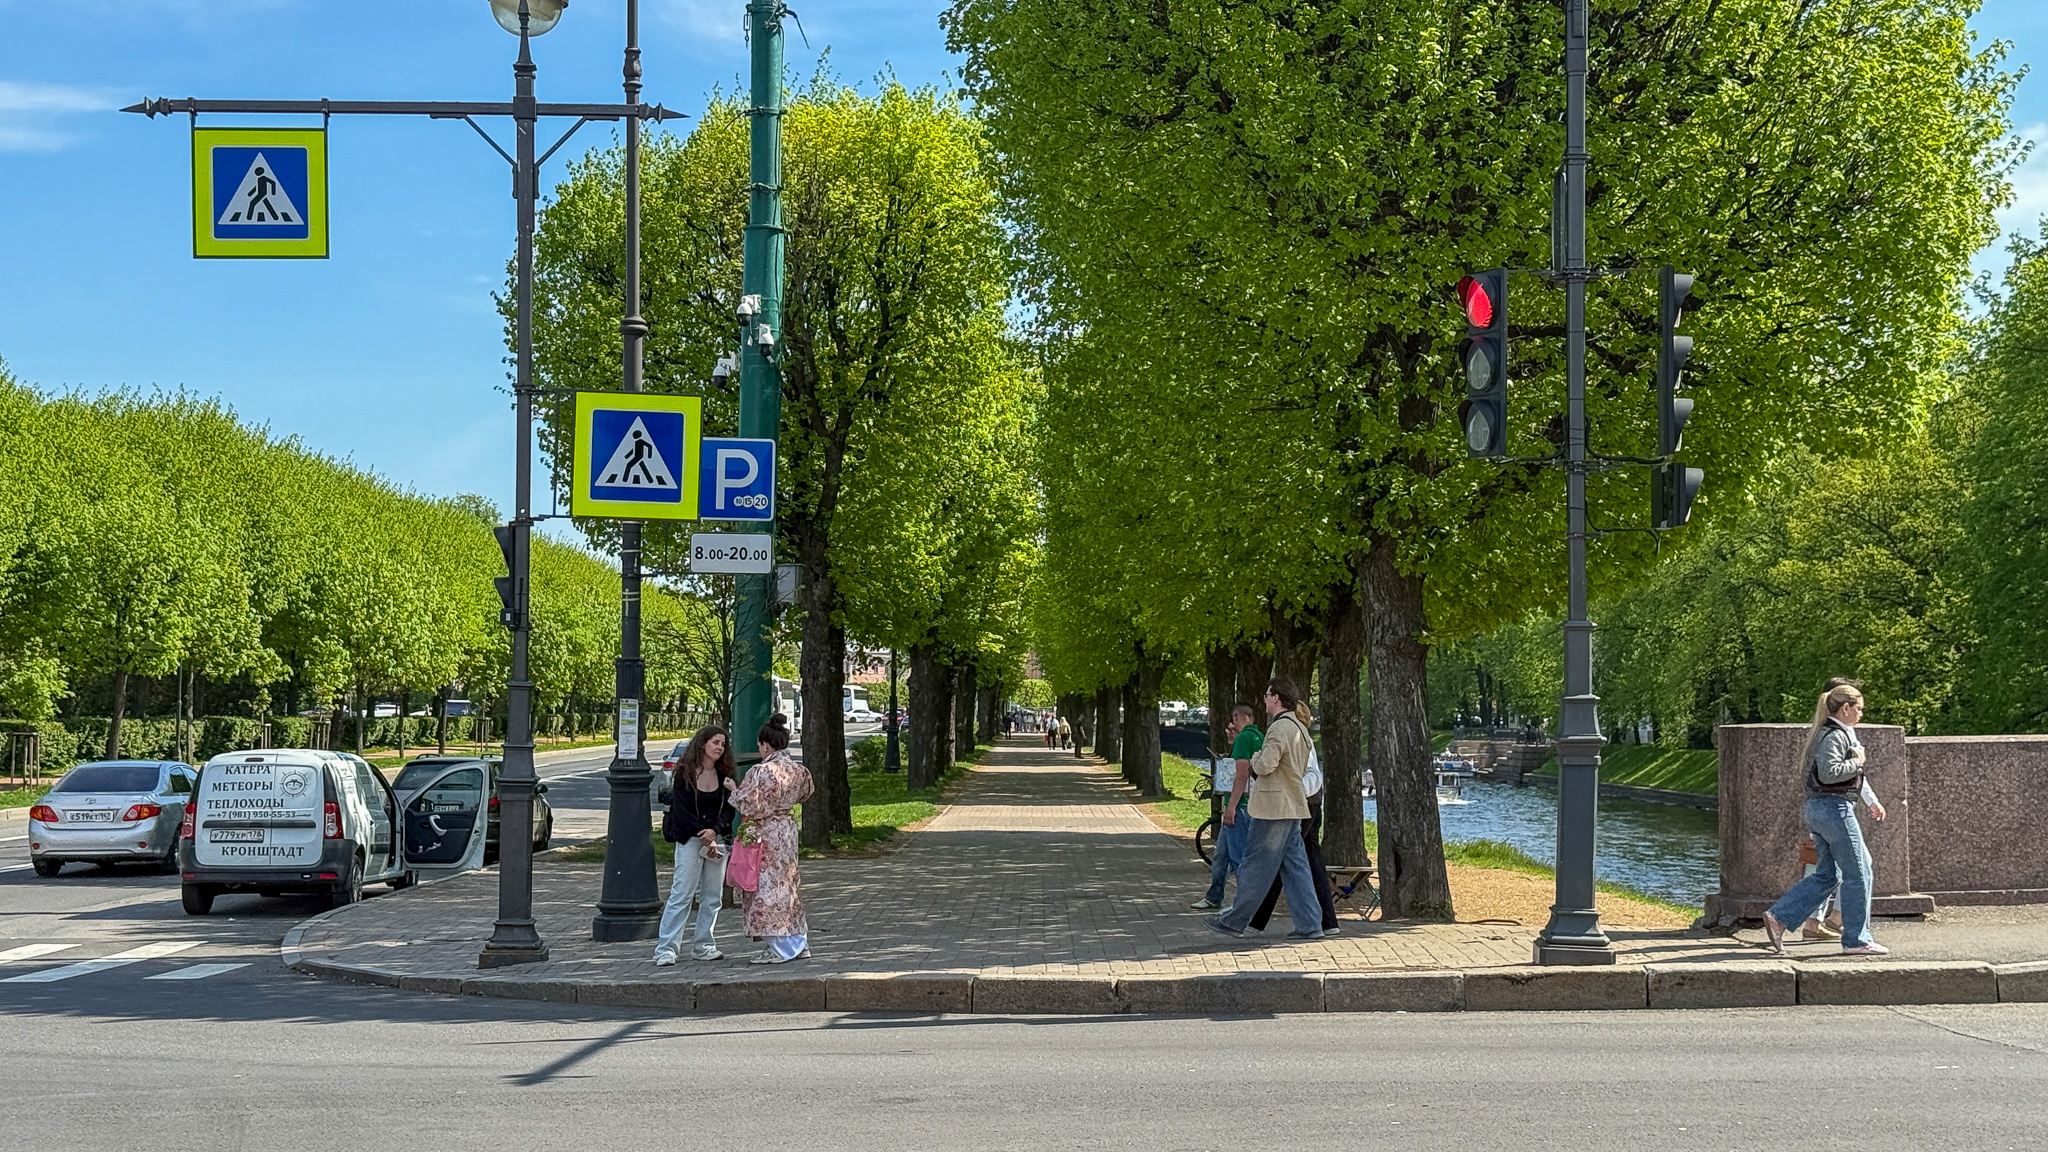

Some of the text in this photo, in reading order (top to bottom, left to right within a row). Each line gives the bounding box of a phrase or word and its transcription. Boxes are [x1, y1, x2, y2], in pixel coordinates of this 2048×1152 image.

[716, 449, 758, 509] P
[754, 497, 767, 507] 20
[694, 546, 768, 561] 8.00-20.00
[225, 765, 271, 775] КАТЕРА
[212, 781, 273, 792] МЕТЕОРЫ
[207, 798, 284, 809] ТЕПЛОХОДЫ
[228, 811, 251, 819] (981)
[221, 846, 305, 858] КРОНШТАДТ
